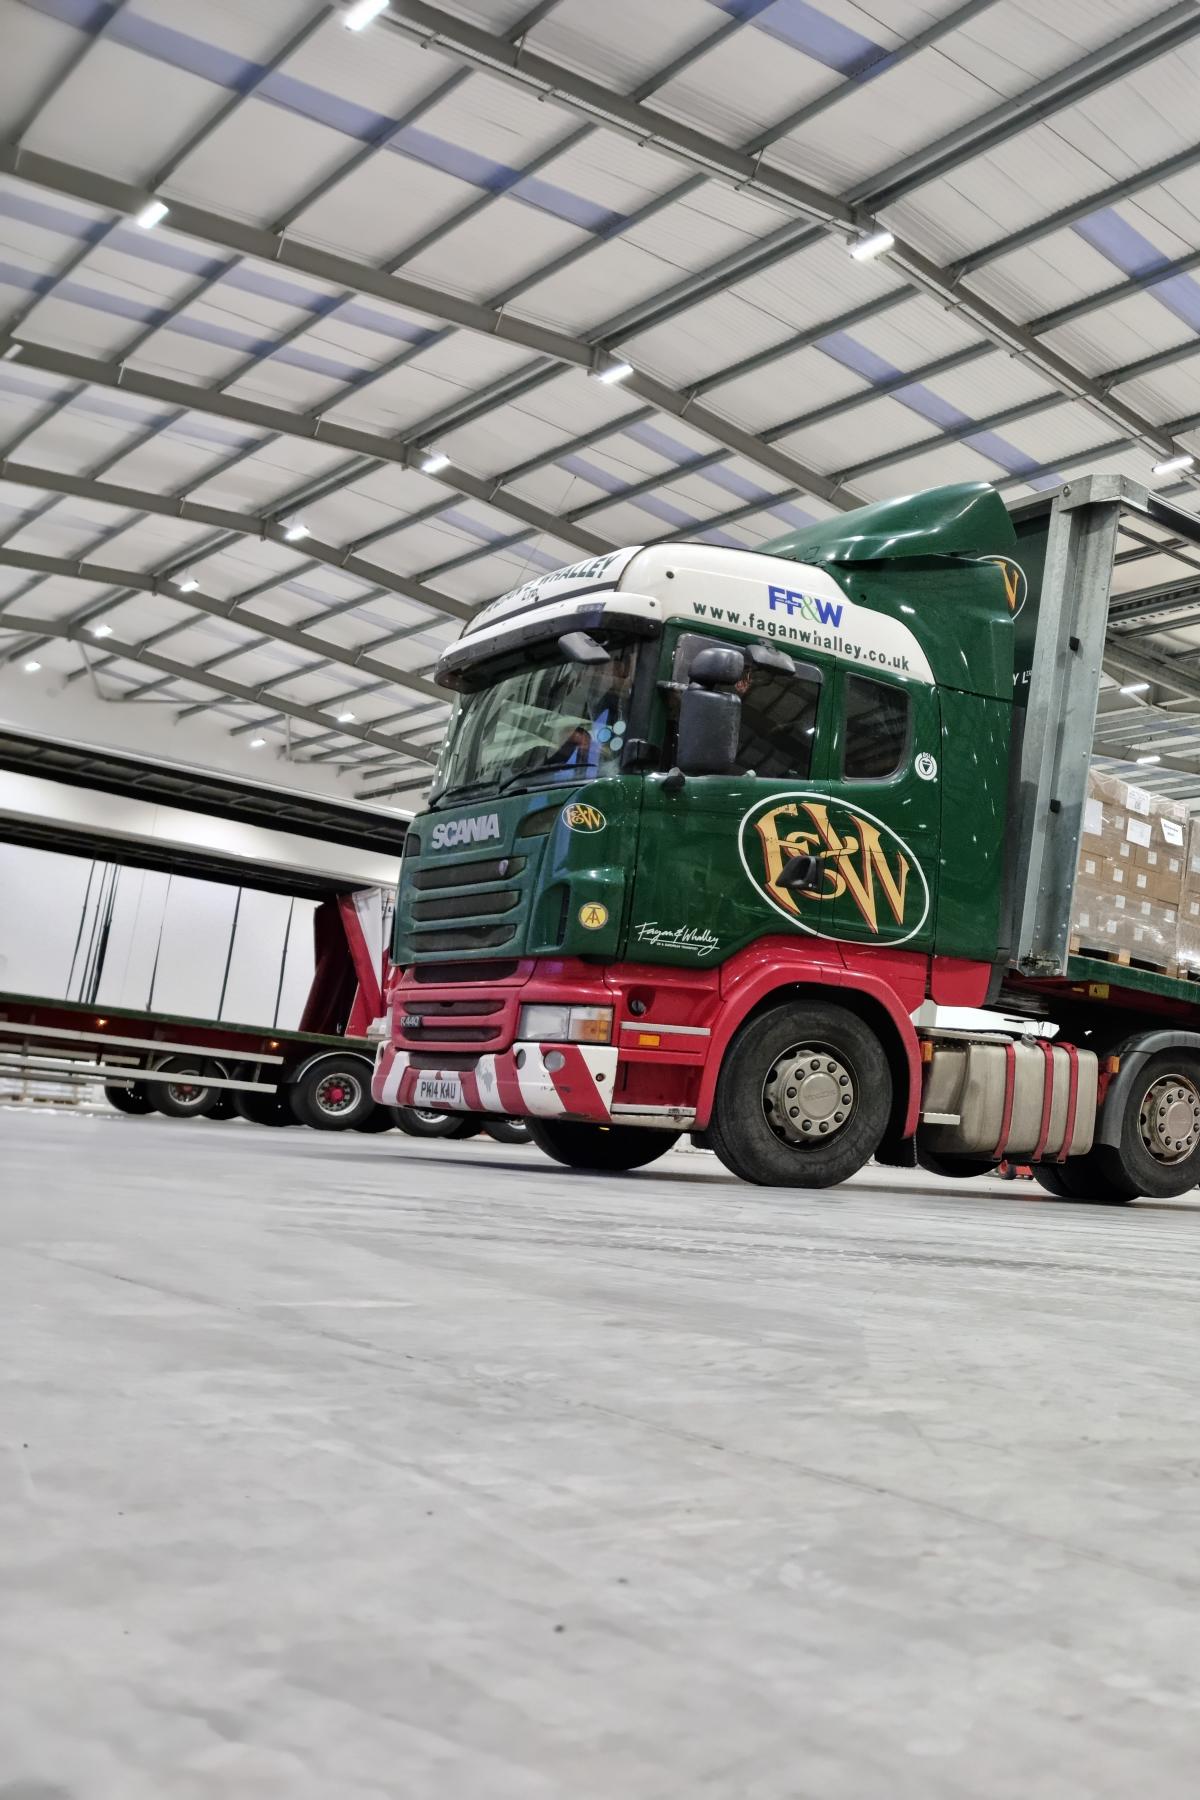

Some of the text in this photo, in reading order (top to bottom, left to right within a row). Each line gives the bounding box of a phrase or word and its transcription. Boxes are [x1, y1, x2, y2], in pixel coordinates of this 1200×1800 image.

[768, 585, 843, 628] FF&W
[692, 602, 910, 672] www.faganwhalley.co.uk
[431, 813, 500, 850] SCANIA
